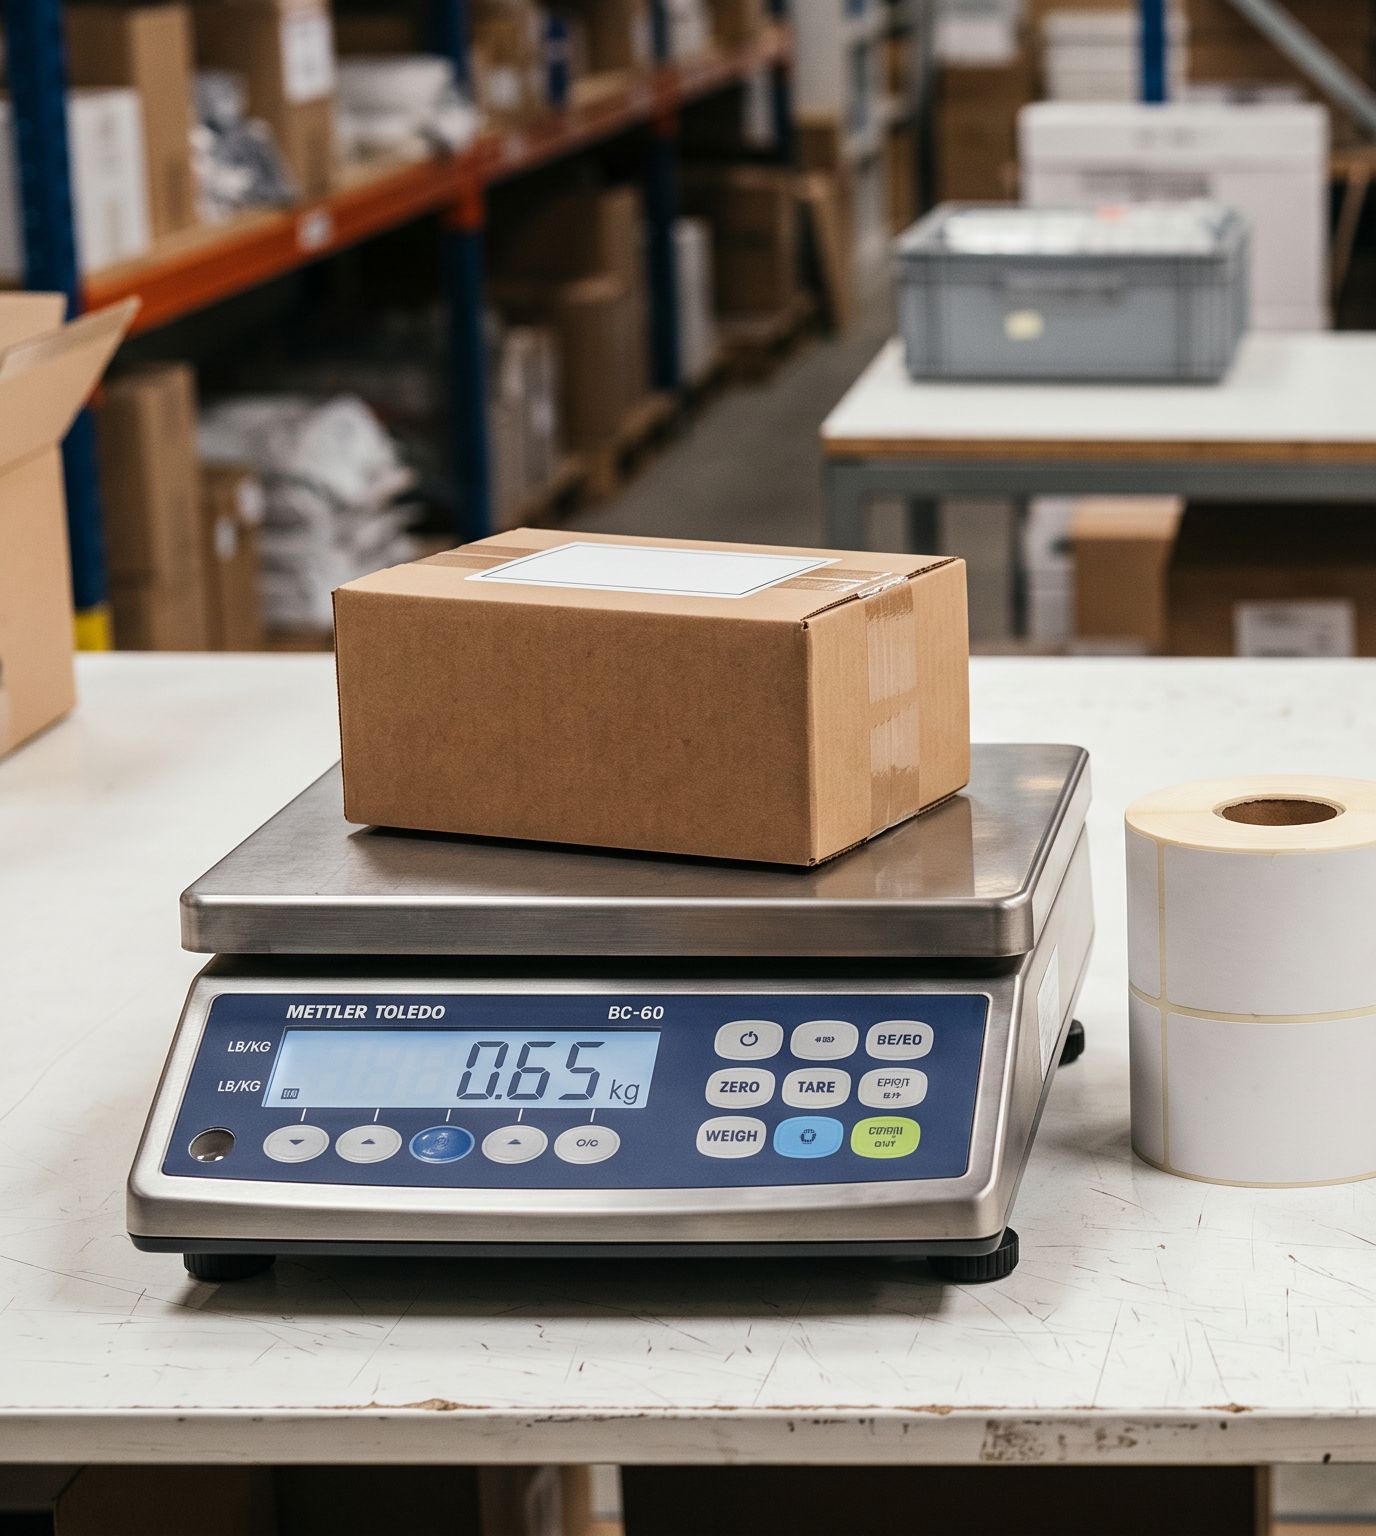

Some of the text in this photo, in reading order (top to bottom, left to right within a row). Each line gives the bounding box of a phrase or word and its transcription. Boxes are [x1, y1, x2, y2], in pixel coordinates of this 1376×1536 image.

[286, 1005, 446, 1020] METTLER TOLEDO
[608, 1005, 665, 1020] BC-60
[227, 1040, 272, 1053] LB/KG
[456, 1041, 640, 1105] 0.65 kg
[217, 1080, 261, 1093] LB/KG
[719, 1081, 760, 1093] ZERO
[797, 1081, 836, 1093] TARE
[706, 1130, 758, 1142] WEIGH
